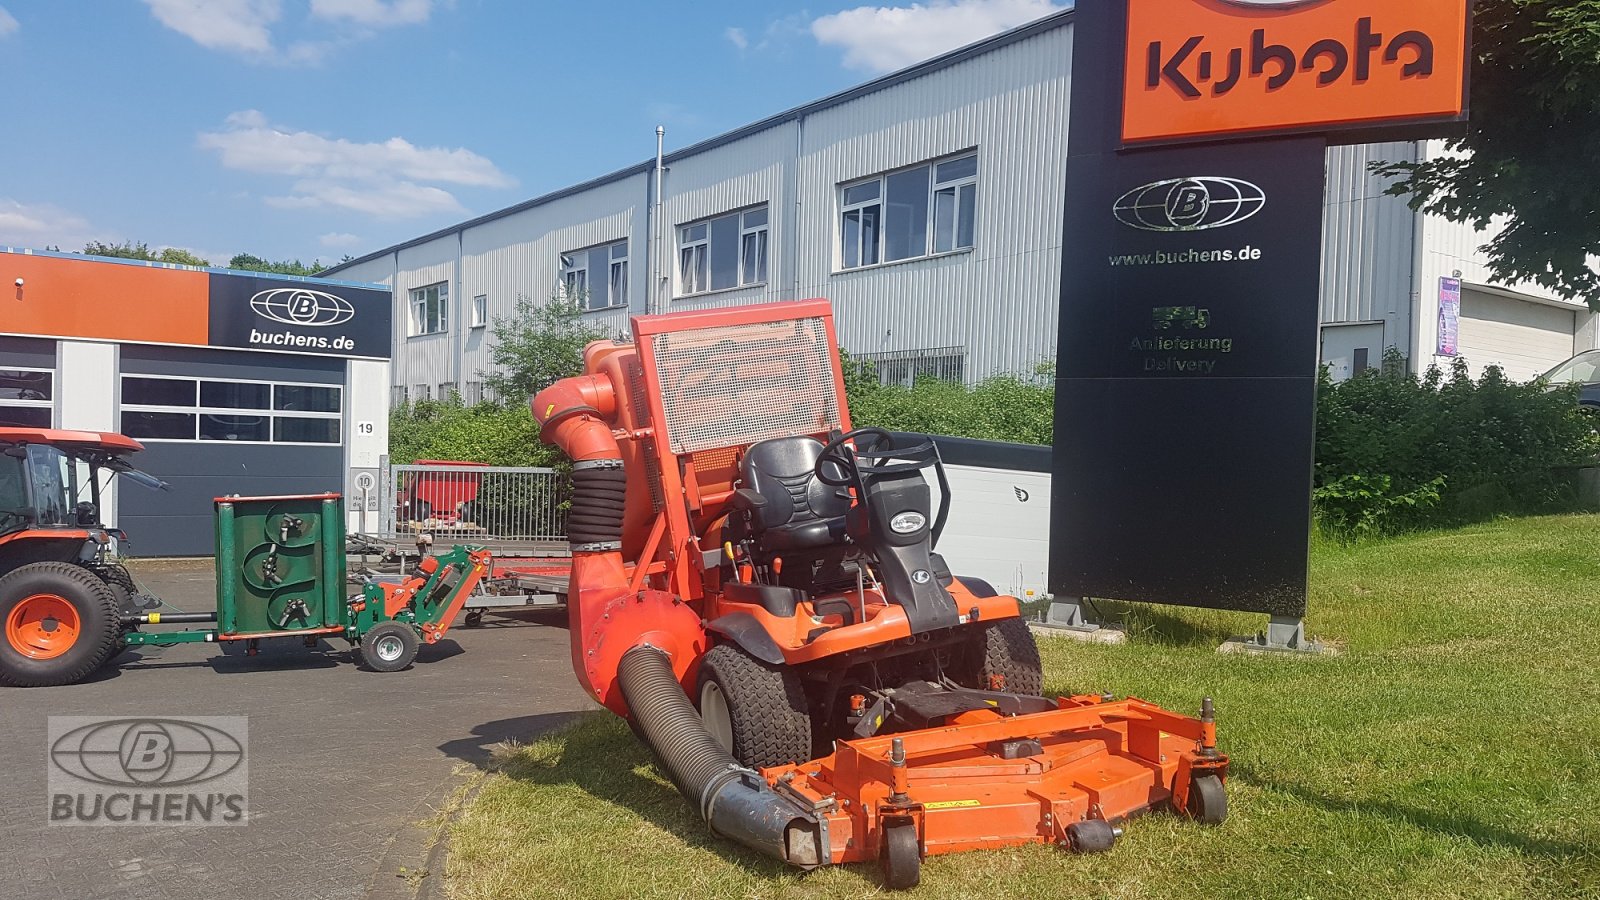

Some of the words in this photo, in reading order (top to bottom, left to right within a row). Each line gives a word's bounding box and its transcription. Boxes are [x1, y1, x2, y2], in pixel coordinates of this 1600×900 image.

[1146, 16, 1434, 98] Kubota
[1108, 245, 1262, 266] www.buchens.de
[249, 328, 355, 351] buchens.de
[1130, 336, 1233, 353] Anlieferung
[1144, 357, 1216, 374] Delivery
[358, 423, 373, 434] 19
[359, 477, 370, 487] 10
